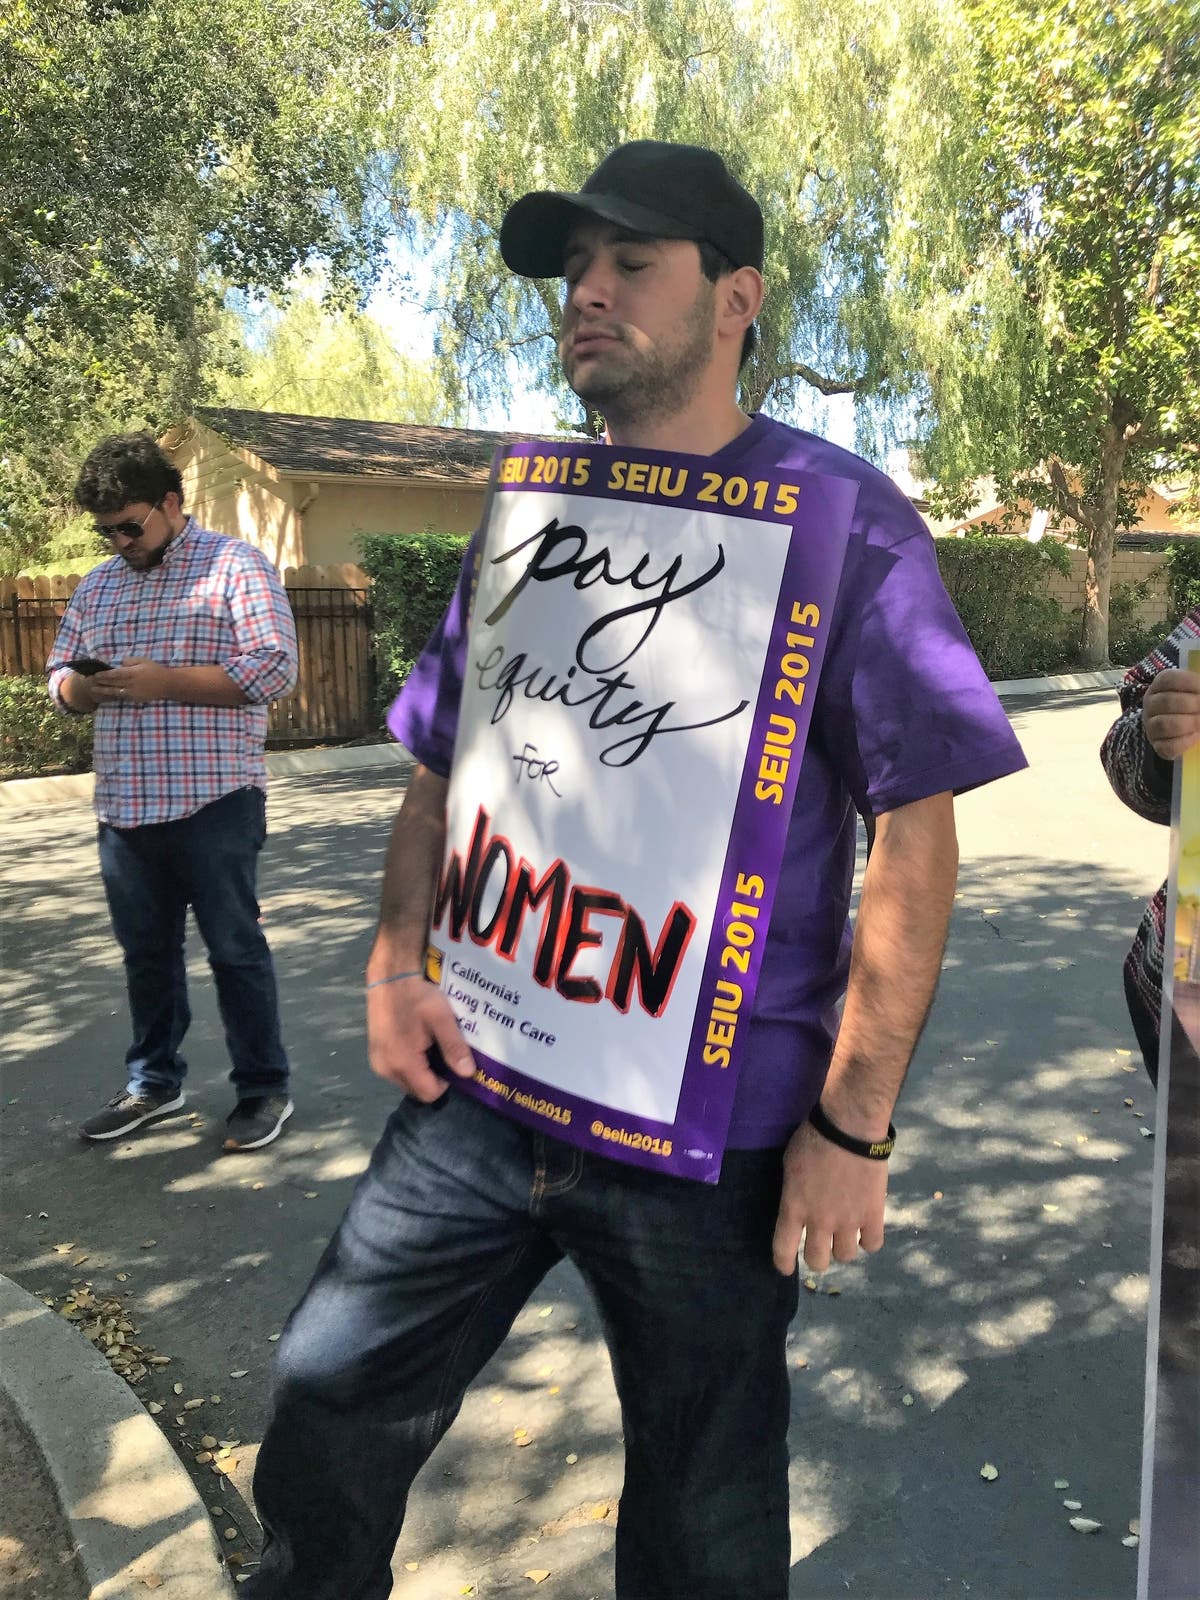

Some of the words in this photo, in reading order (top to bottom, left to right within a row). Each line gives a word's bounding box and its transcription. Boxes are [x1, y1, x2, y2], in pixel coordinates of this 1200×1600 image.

[529, 455, 592, 486] 2015
[607, 460, 688, 498] SEIU
[696, 472, 801, 515] 2015
[485, 518, 725, 675] pay
[775, 601, 821, 706] 2015
[476, 646, 750, 767] equity
[755, 713, 797, 805] SEIU
[432, 803, 698, 1019] WOMEN
[721, 872, 765, 974] 2015
[447, 983, 479, 1013] Long
[483, 1001, 515, 1029] Term
[519, 1021, 557, 1046] Care
[451, 961, 521, 1005] California's
[703, 980, 743, 1069] SEIU
[590, 1120, 673, 1157] @seiu2015
